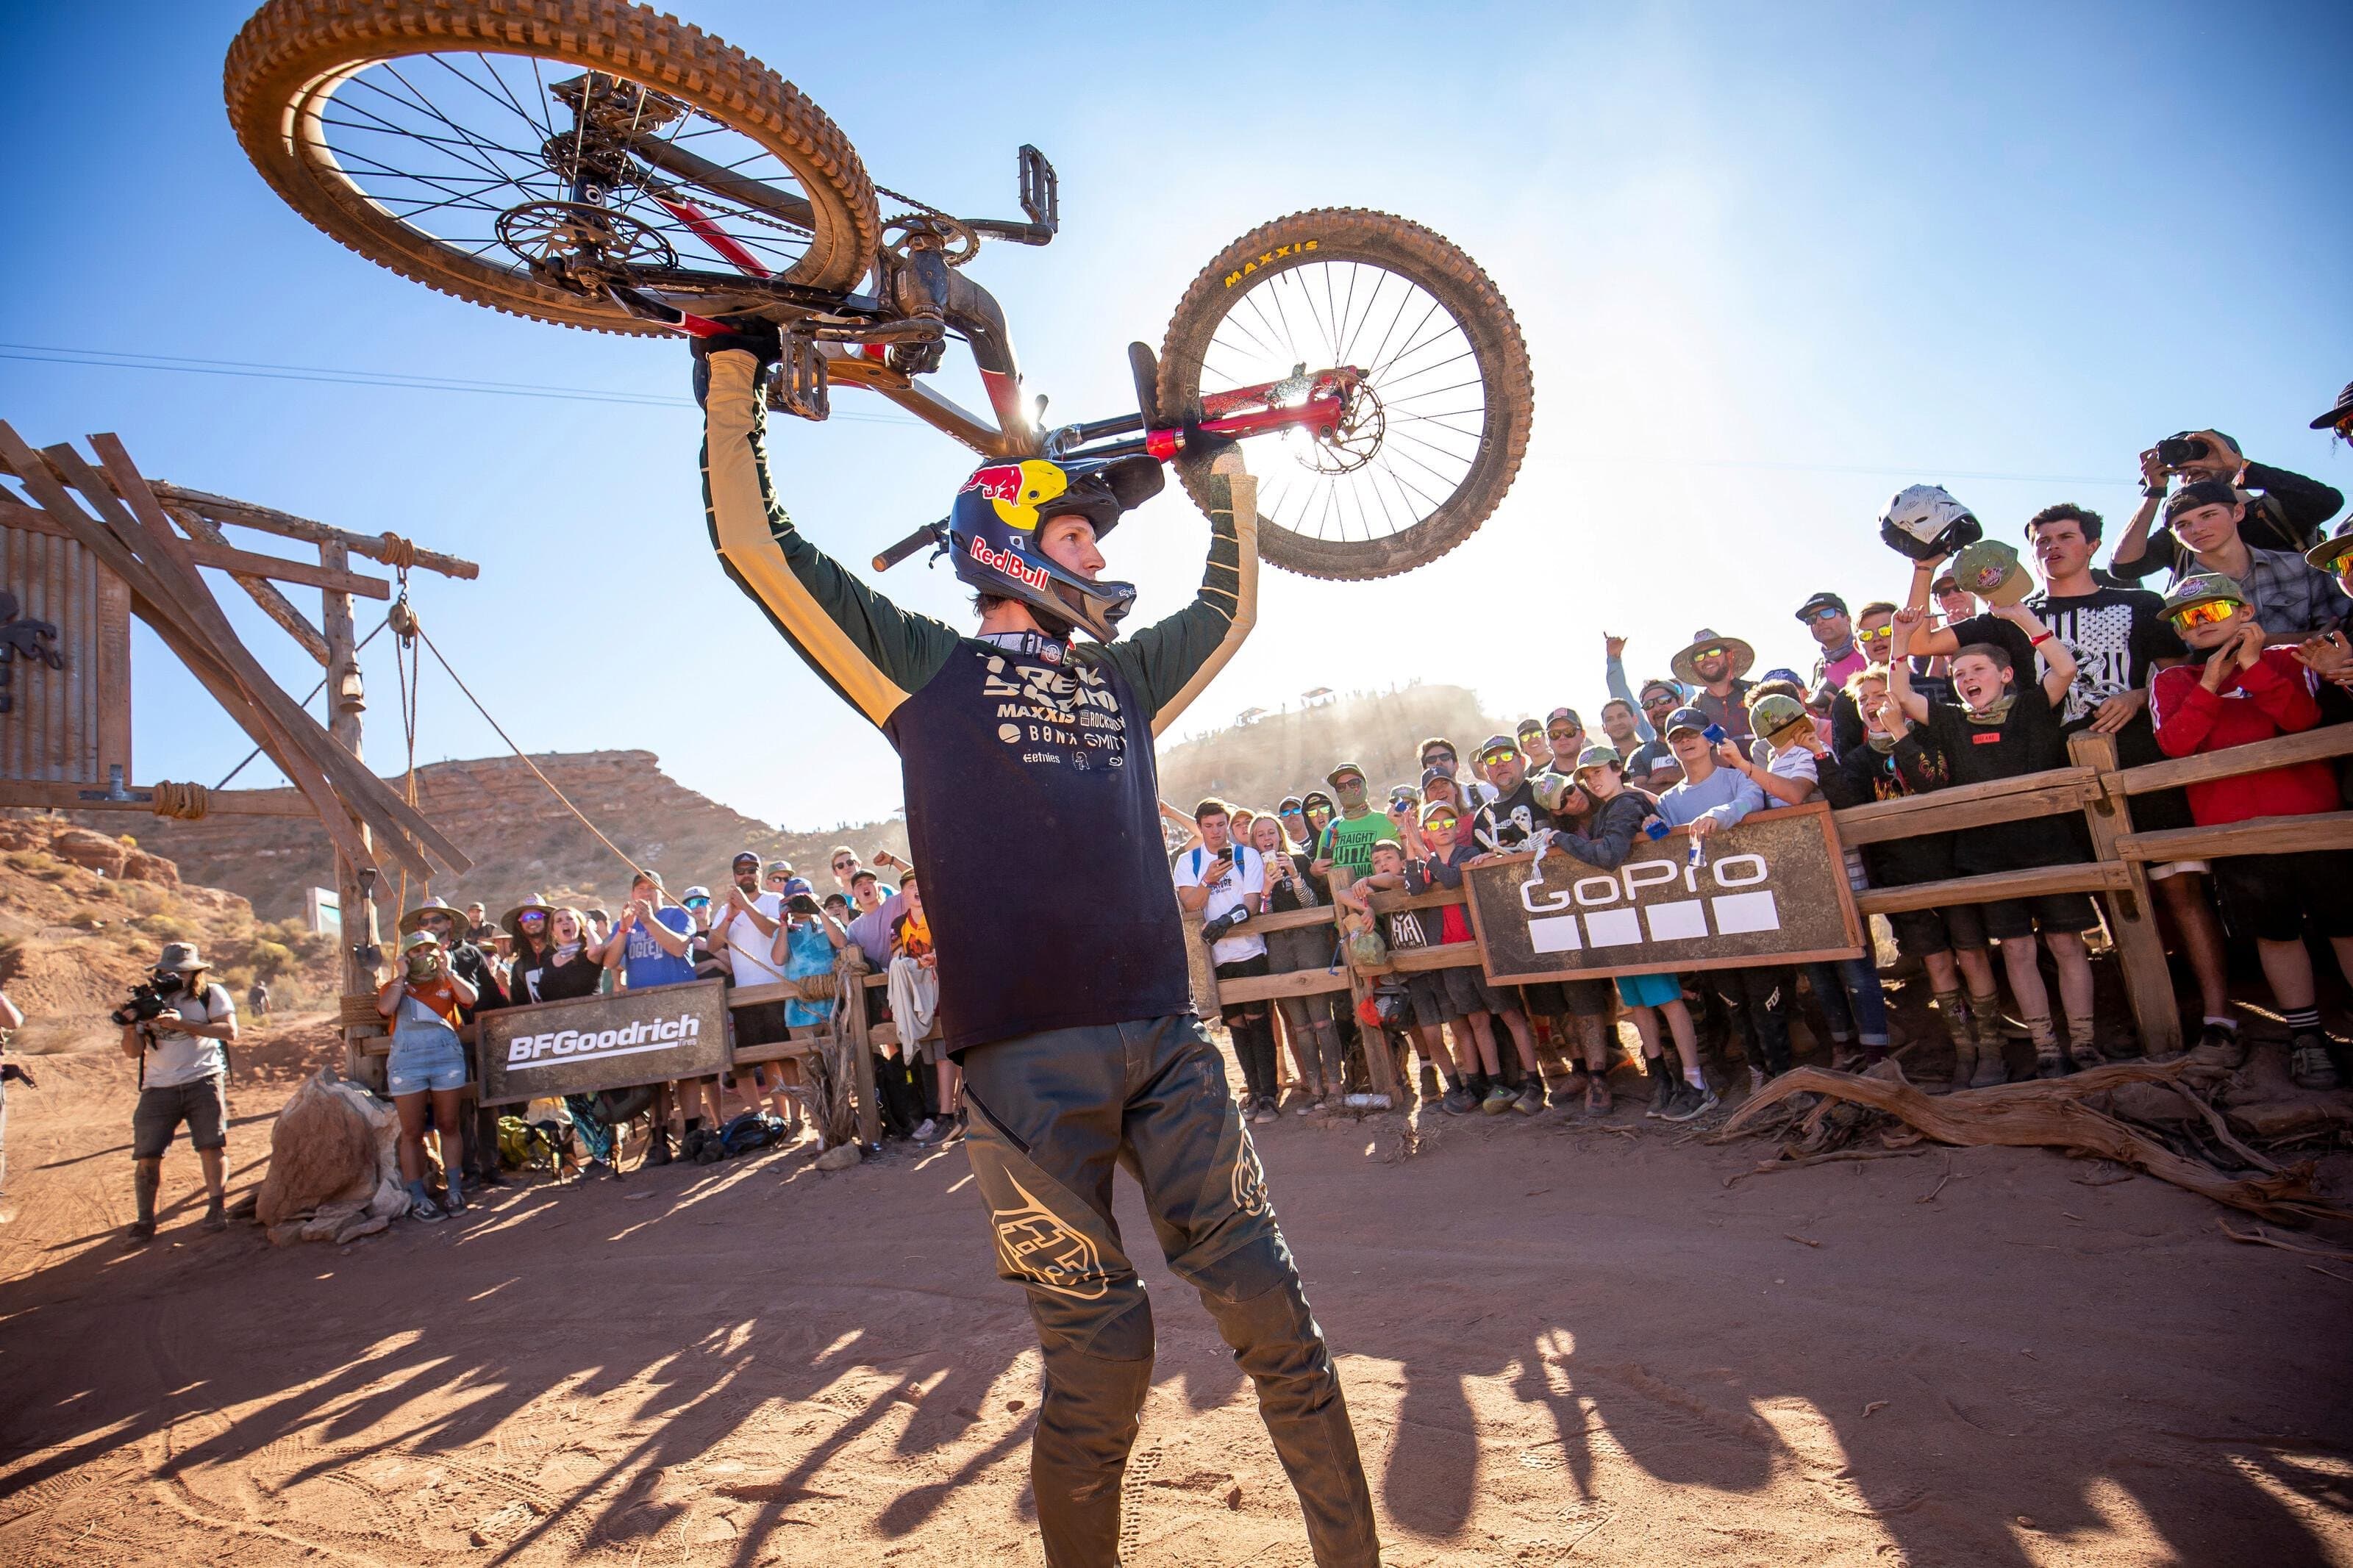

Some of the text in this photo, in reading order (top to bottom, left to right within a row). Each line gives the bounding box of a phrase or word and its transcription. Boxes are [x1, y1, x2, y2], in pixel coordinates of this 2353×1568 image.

[1224, 240, 1318, 289] MAXXIS
[971, 535, 1051, 592] Red Bull
[996, 704, 1076, 724] MAXXIS
[1032, 752, 1060, 764] etnies
[1336, 831, 1375, 845] TRAIGHT
[1519, 853, 1768, 913] GoPro
[1765, 986, 1780, 1012] FOX
[508, 1014, 699, 1062] BFGoodrich
[678, 1038, 697, 1048] Tires
